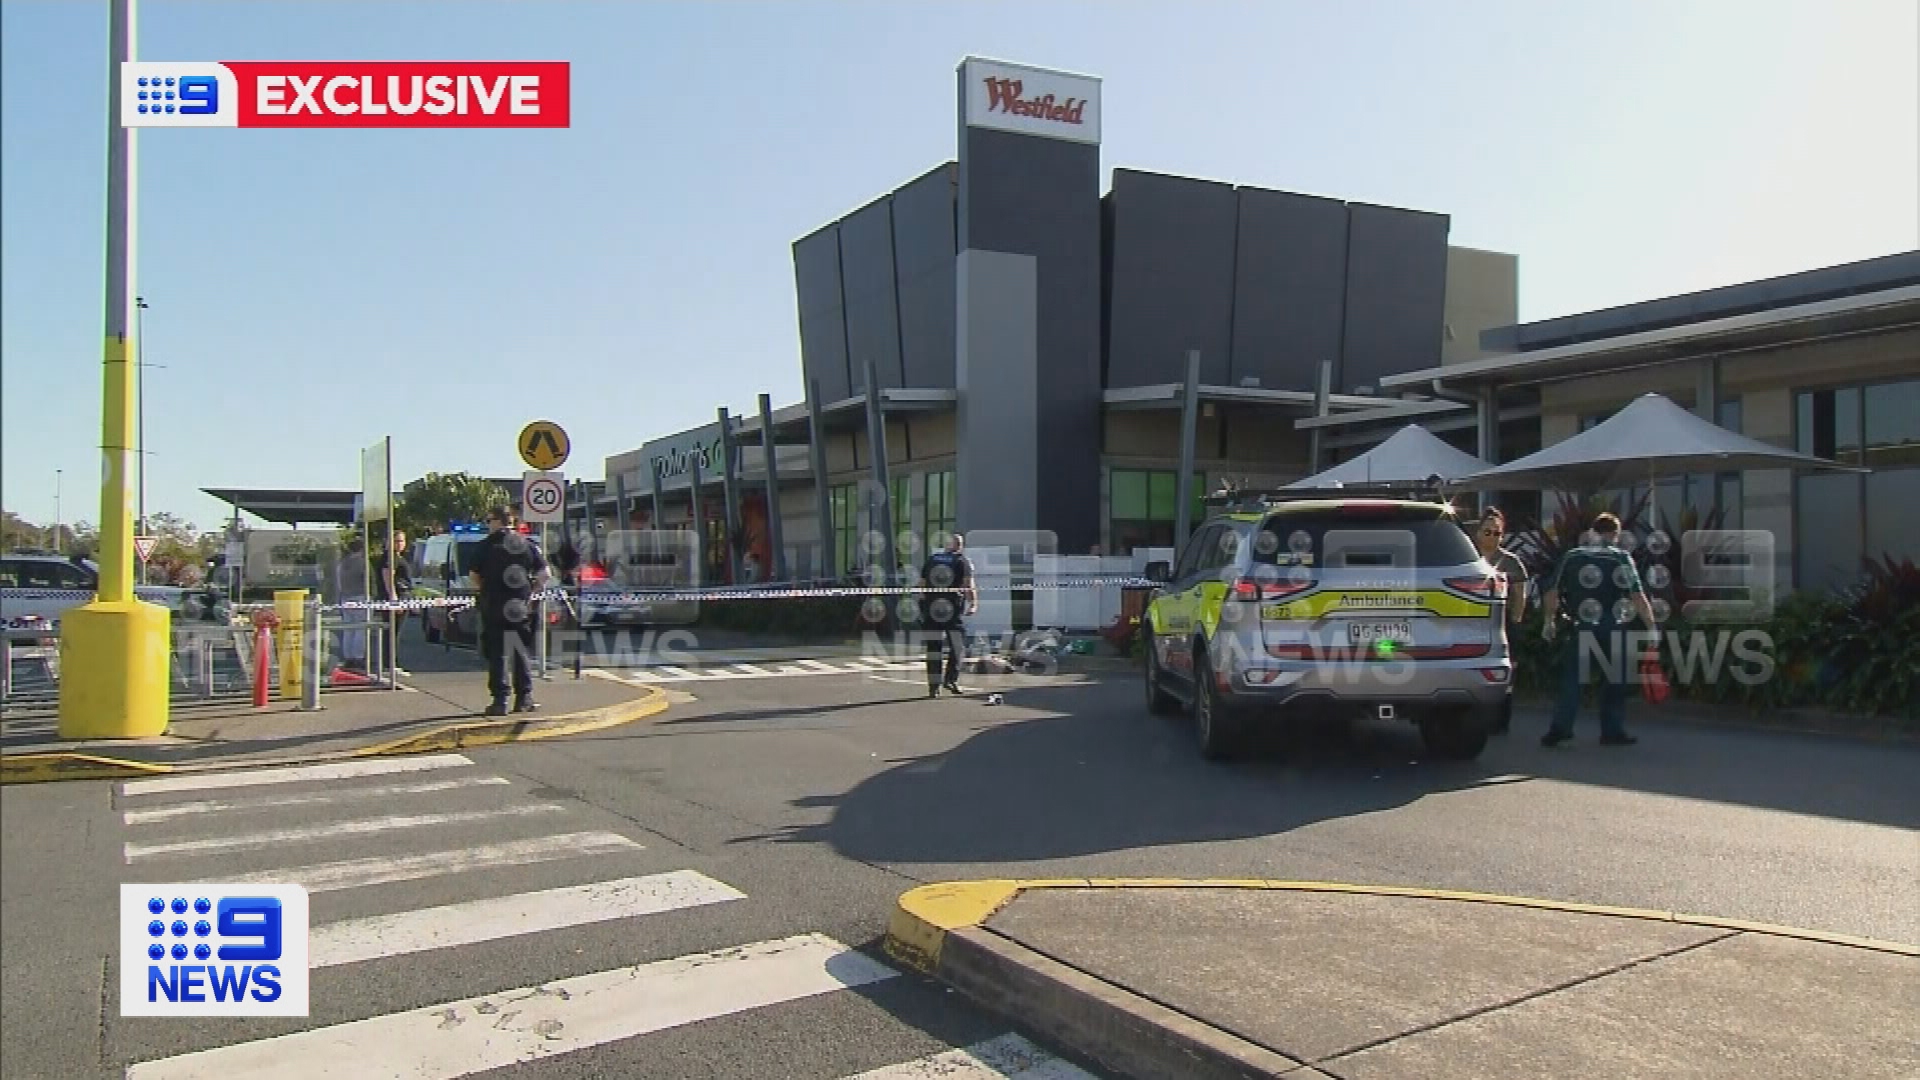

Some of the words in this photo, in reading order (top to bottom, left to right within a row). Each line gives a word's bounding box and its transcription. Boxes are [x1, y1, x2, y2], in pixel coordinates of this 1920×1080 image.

[983, 76, 1088, 124] Westfield
[532, 488, 556, 505] 20
[1339, 594, 1425, 607] Ambulance
